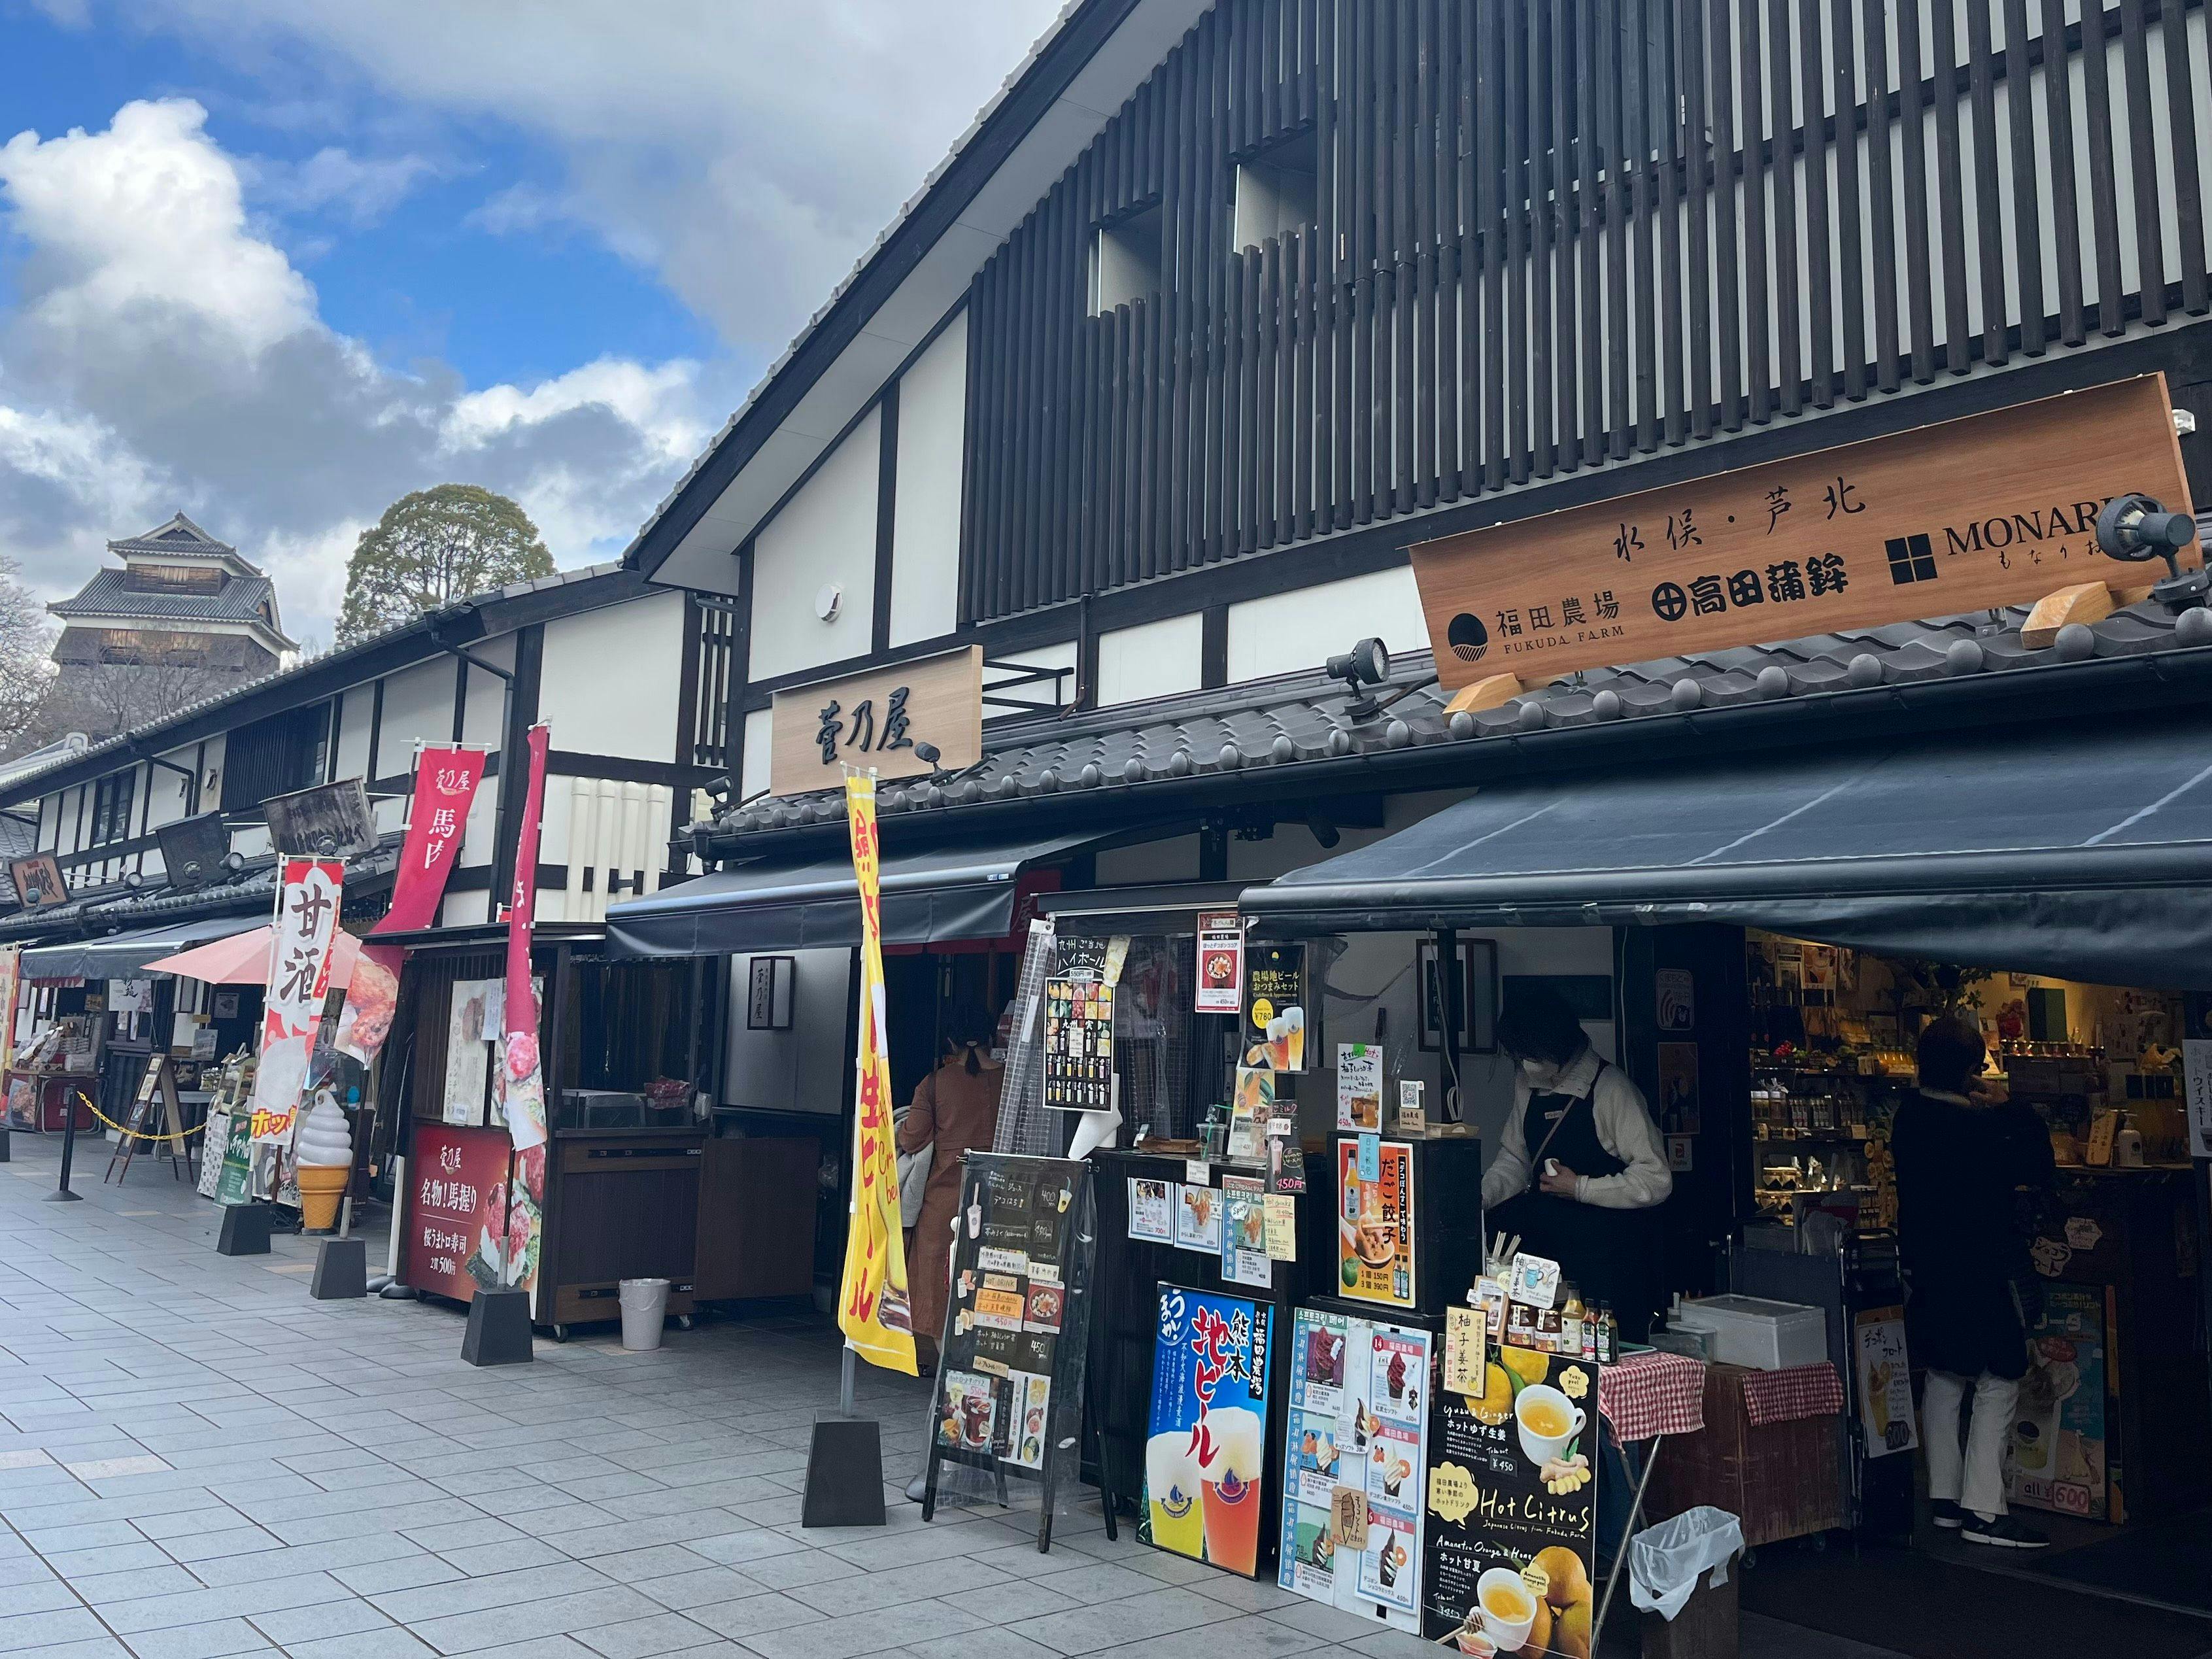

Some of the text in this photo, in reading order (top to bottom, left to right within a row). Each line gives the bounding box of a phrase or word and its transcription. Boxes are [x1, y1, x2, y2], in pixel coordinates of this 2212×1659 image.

[1612, 475, 1867, 561] 水俣・芦北
[1943, 492, 2147, 556] MONAR
[1690, 551, 1849, 616] 高田蒲鉾
[1495, 590, 1622, 640] 福田農場
[1503, 624, 1625, 655] FUKUDA FARM
[280, 883, 332, 1003] 甘酒
[1252, 972, 1299, 982] 農場地ビール
[1253, 983, 1298, 991] おつまみセット
[1382, 1159, 1396, 1244] だご餃子
[1031, 1340, 1046, 1353] 450
[1227, 1310, 1250, 1382] 熊本
[1374, 1339, 1382, 1348] 14
[1457, 1314, 1471, 1383] 柚子姜茶
[1185, 1307, 1233, 1467] 地ビール
[1437, 1478, 1468, 1489] 福田農場より
[1493, 1459, 1514, 1471] ¥450
[1436, 1497, 1470, 1509] ホットドリンク
[1480, 1488, 1590, 1532] Hot Citrus
[1440, 1552, 1481, 1573] ホット甘夏
